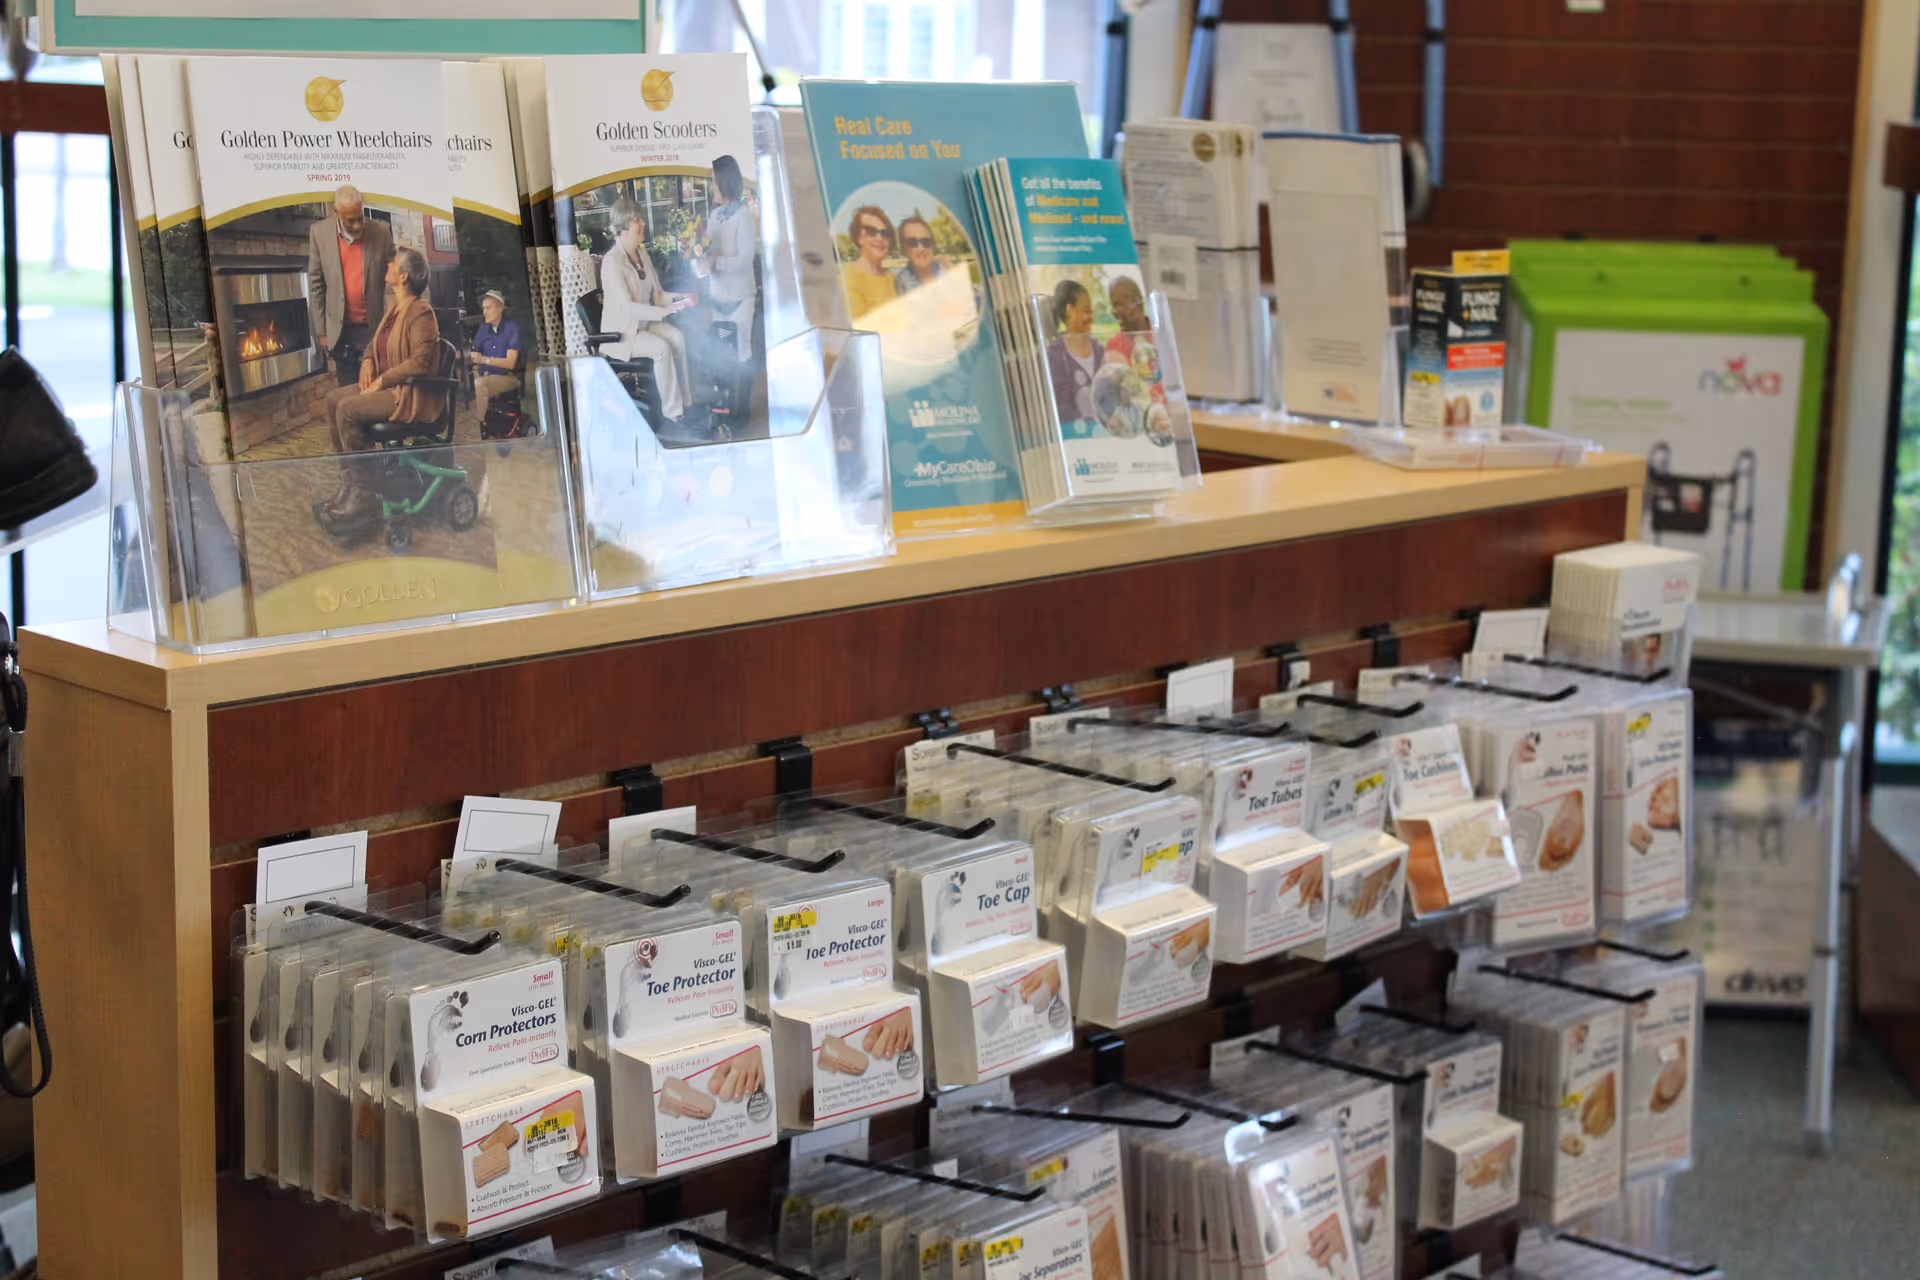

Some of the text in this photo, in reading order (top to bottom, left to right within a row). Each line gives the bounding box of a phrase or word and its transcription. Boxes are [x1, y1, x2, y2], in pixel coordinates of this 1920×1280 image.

[596, 120, 717, 141] Golden Scooters
[834, 116, 912, 135] Real Care
[220, 129, 433, 148] Golden Power Wheelchairs
[266, 153, 303, 161] DEPENDABLE
[304, 153, 320, 161] WITH
[321, 153, 352, 161] MAXIMUM
[840, 139, 961, 159] Focused on You
[253, 162, 282, 171] SUPERIOR
[283, 162, 311, 171] STABILITY
[311, 162, 325, 170] AND
[325, 162, 354, 170] GREATEST
[307, 174, 333, 182] SPRING
[1022, 177, 1039, 190] Get
[1040, 177, 1051, 190] all
[1052, 177, 1067, 190] the
[1025, 195, 1036, 207] of
[1082, 196, 1099, 207] and
[1698, 368, 1783, 396] nova
[1249, 788, 1303, 811] Toe Tubes
[995, 873, 1029, 889] Visco-GEL
[977, 885, 1031, 911] Toe Cap
[715, 929, 734, 940] Small
[848, 919, 885, 935] Visco-GEL
[828, 933, 886, 956] Protector
[693, 953, 735, 969] Visco-GEL
[532, 970, 554, 983] Small
[647, 968, 736, 997] Toe Protector
[667, 993, 691, 1005] Relieves
[692, 989, 707, 999] Pain
[511, 998, 556, 1017] Visco-GEL
[455, 1012, 557, 1048] Corn Protectors
[488, 1029, 558, 1053] Relieve Pain Instantly
[531, 1045, 557, 1061] PediFix
[464, 1106, 524, 1130] STRETCHABLE
[476, 1188, 501, 1202] Cushion
[508, 1180, 530, 1191] Protect
[476, 1199, 498, 1213] Absorb
[499, 1193, 523, 1206] Pressure
[531, 1183, 553, 1195] Friction
[1034, 1253, 1083, 1279] Separators
